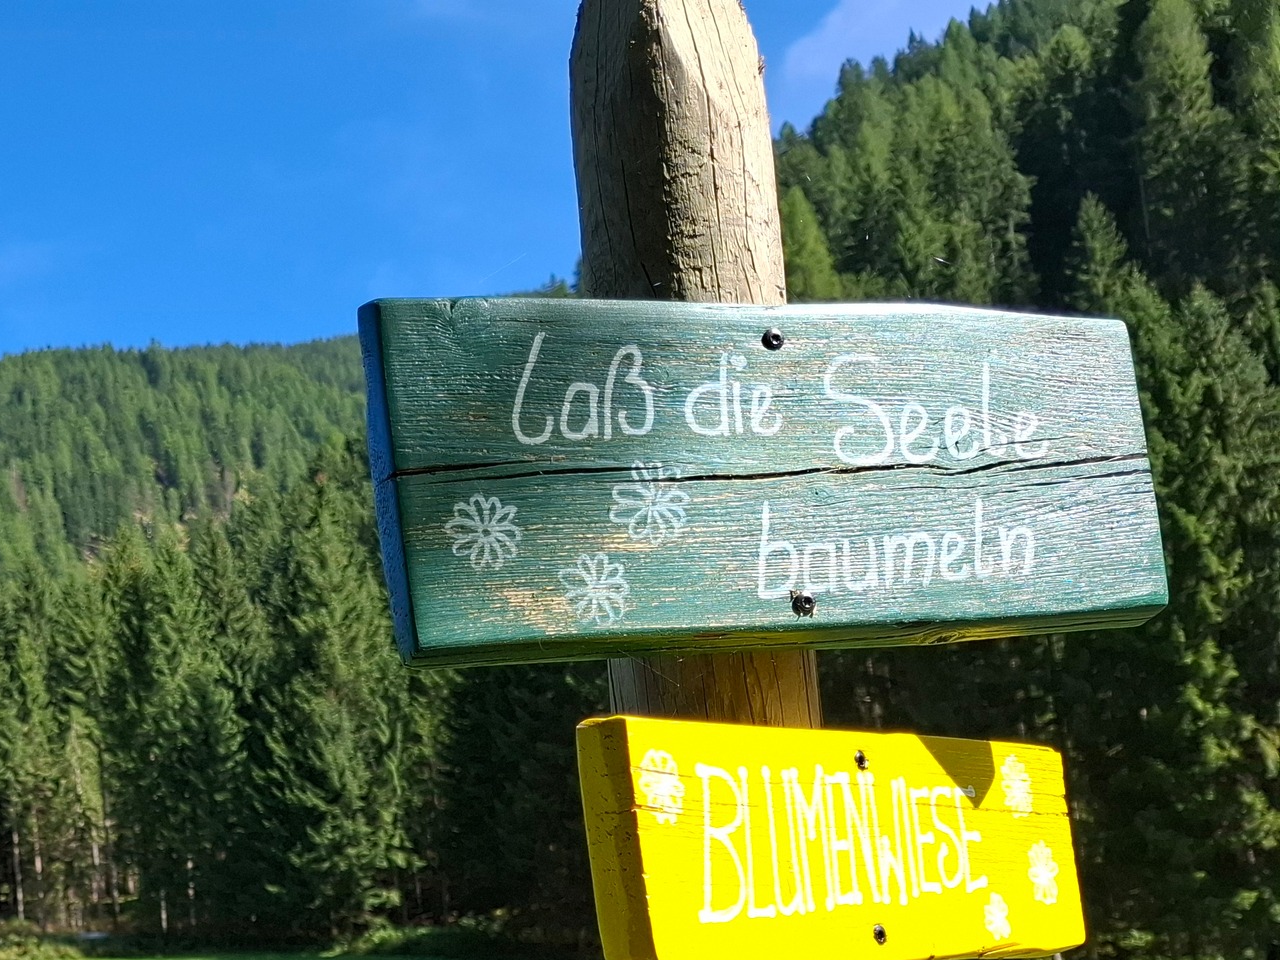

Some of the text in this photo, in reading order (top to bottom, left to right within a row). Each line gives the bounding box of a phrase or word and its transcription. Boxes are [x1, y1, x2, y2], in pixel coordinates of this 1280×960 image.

[512, 332, 1050, 465] Laß die Seele
[757, 498, 1035, 599] baumeln
[694, 763, 988, 924] BLUMENWIESE
